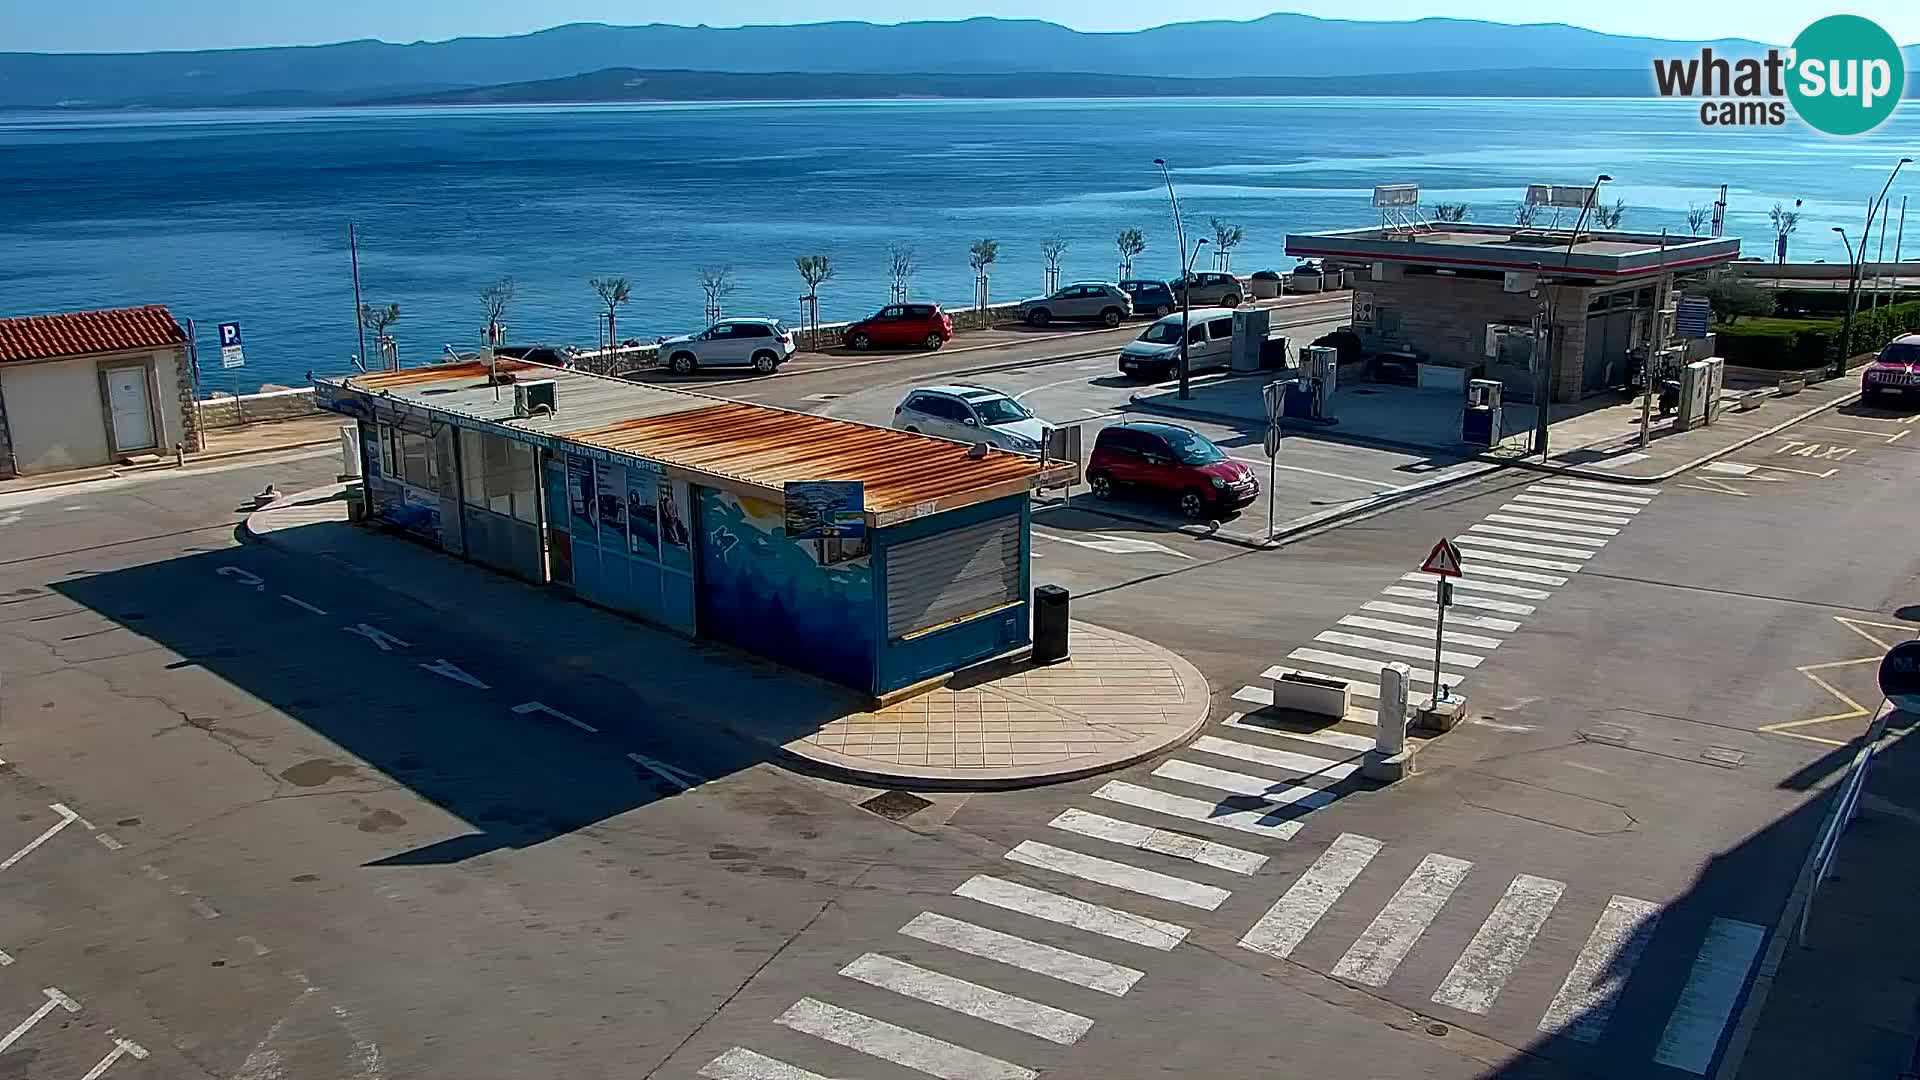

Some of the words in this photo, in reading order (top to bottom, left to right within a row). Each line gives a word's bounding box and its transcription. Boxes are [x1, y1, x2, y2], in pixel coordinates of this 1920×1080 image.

[223, 325, 236, 344] P
[575, 446, 607, 460] STATION
[610, 454, 635, 467] TICKET
[636, 460, 662, 473] OFFICE
[1776, 441, 1857, 460] TAXI
